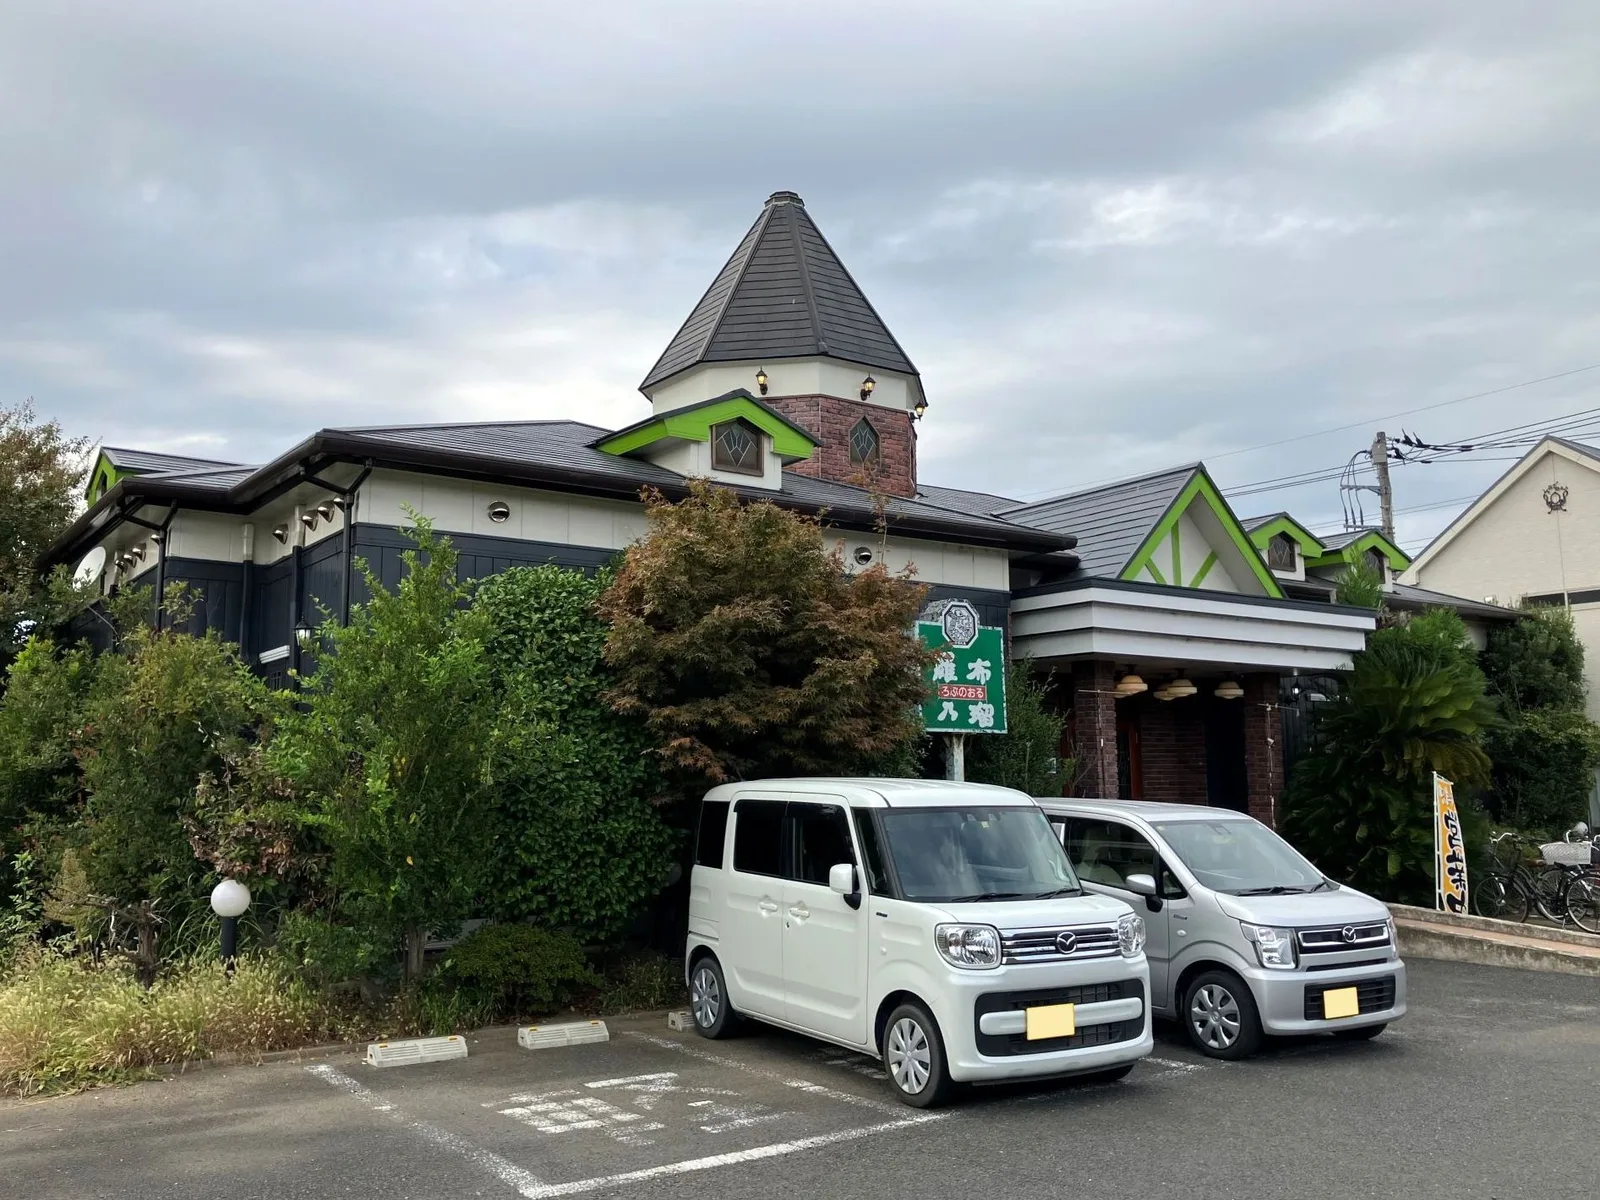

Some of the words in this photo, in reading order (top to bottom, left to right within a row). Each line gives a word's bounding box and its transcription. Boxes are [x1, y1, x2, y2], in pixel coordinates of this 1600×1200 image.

[941, 686, 984, 699] ろぶのおる
